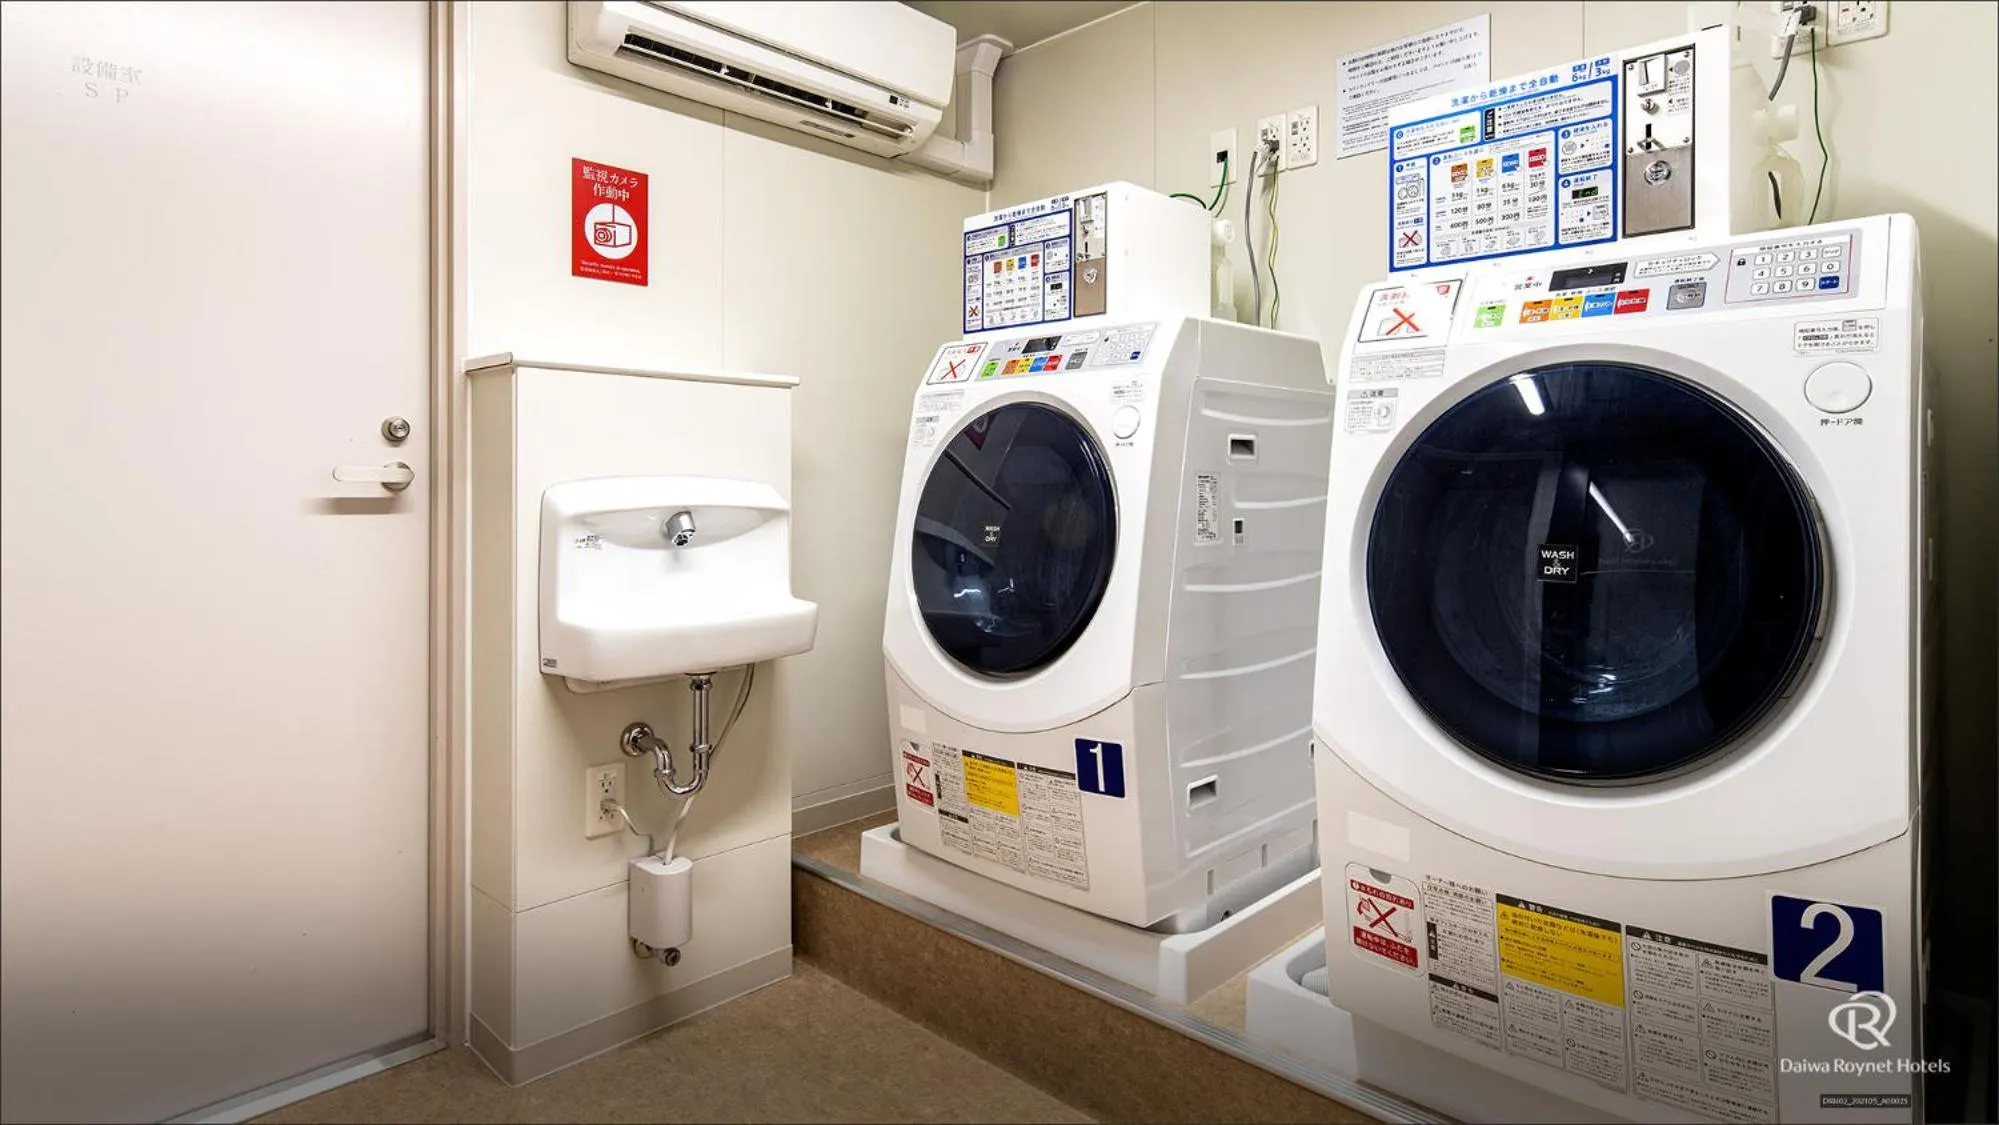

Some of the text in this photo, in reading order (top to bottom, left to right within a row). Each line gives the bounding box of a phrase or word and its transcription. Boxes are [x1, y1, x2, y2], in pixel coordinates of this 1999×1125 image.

[1451, 74, 1559, 107] 洗濯から乾燥まで全自動
[582, 165, 639, 188] 監視カメラ
[593, 182, 631, 202] 作動中
[1541, 550, 1575, 560] WASH
[1543, 566, 1570, 576] DRY
[1089, 743, 1105, 792] 1
[1799, 902, 1859, 994] 2
